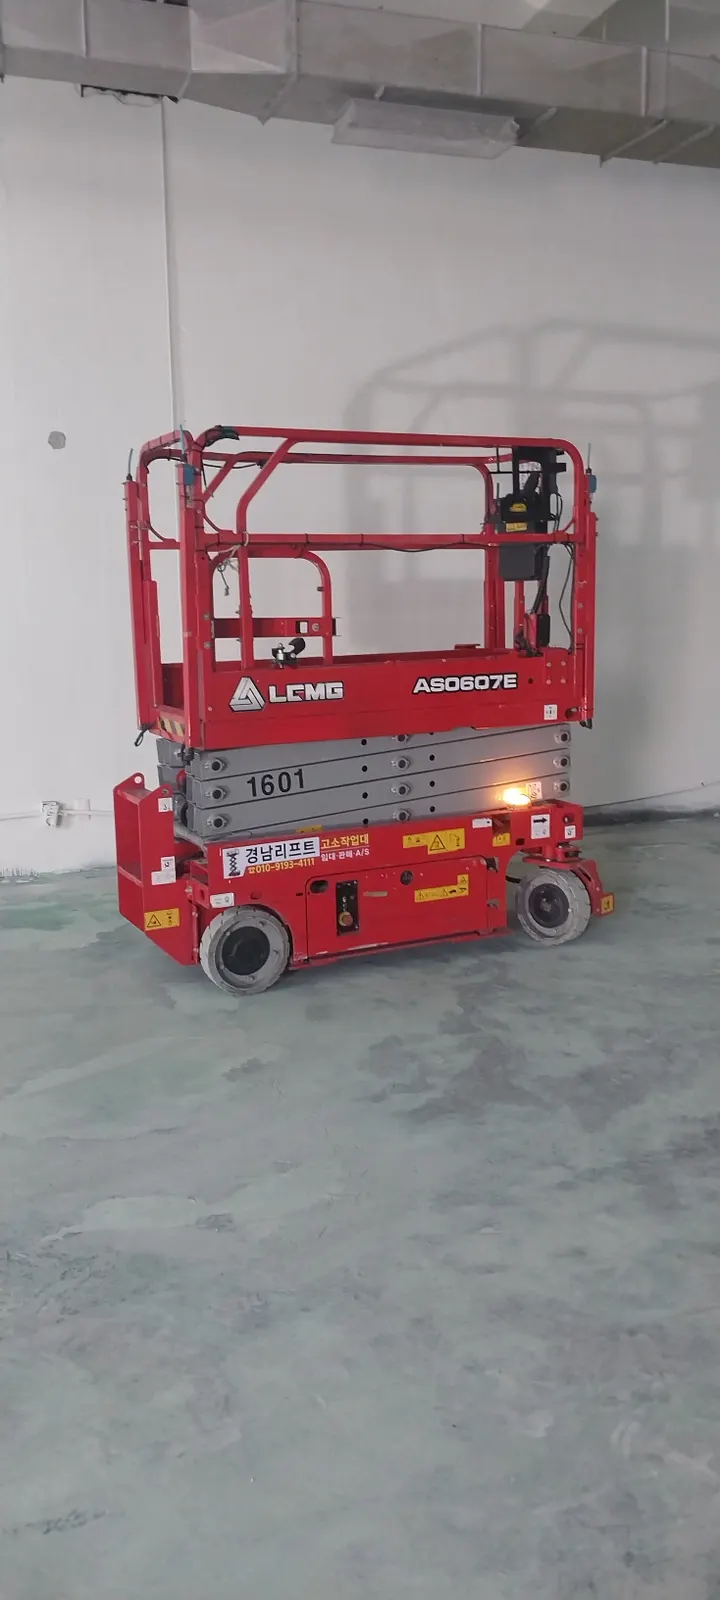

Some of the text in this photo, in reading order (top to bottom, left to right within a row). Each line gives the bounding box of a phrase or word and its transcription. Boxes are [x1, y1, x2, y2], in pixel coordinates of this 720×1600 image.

[412, 673, 518, 695] AS0607E
[246, 768, 304, 797] 1601
[245, 840, 316, 864] 경남리프트
[321, 833, 369, 850] 고소작업대
[255, 857, 315, 874] 010-9193-4111
